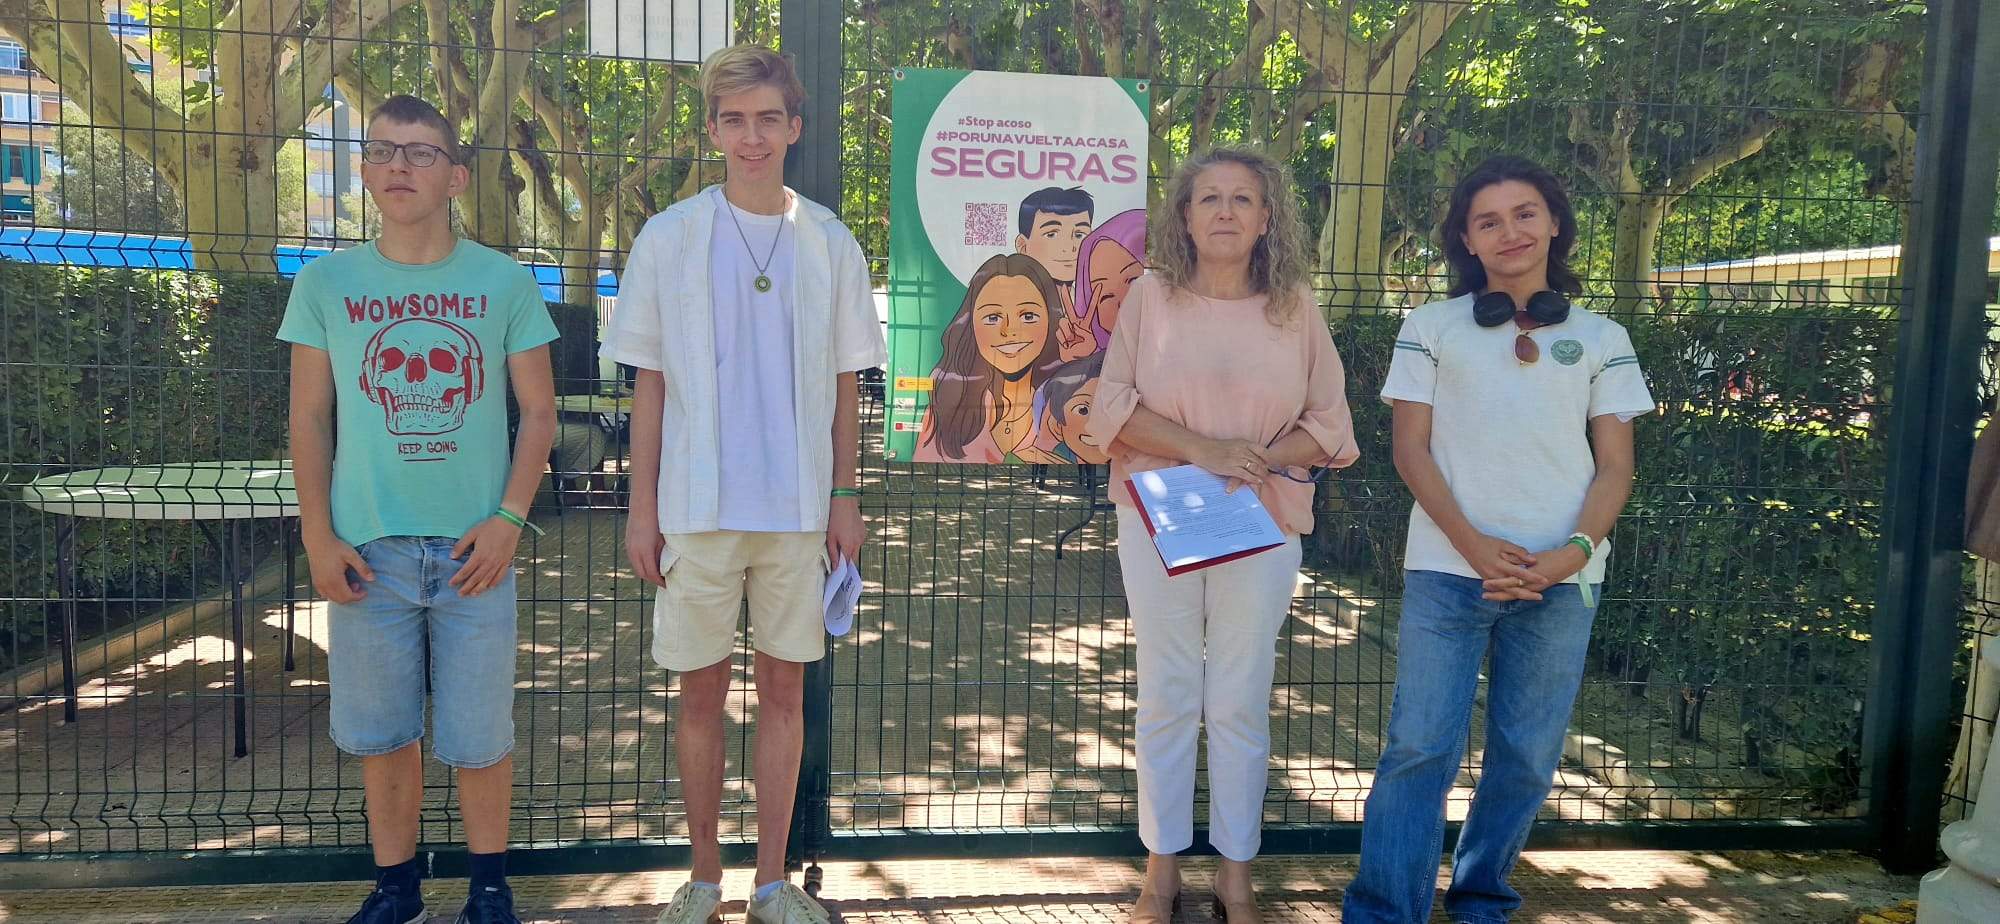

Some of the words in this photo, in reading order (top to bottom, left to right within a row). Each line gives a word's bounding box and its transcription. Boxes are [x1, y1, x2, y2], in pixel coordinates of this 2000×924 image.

[958, 116, 994, 129] #Stop
[996, 120, 1032, 129] acoso
[936, 130, 1129, 148] #PORUNAVUELTAACASA
[930, 147, 1138, 184] SEGURAS
[344, 293, 487, 324] WOWSOME!
[398, 442, 421, 454] KEEP
